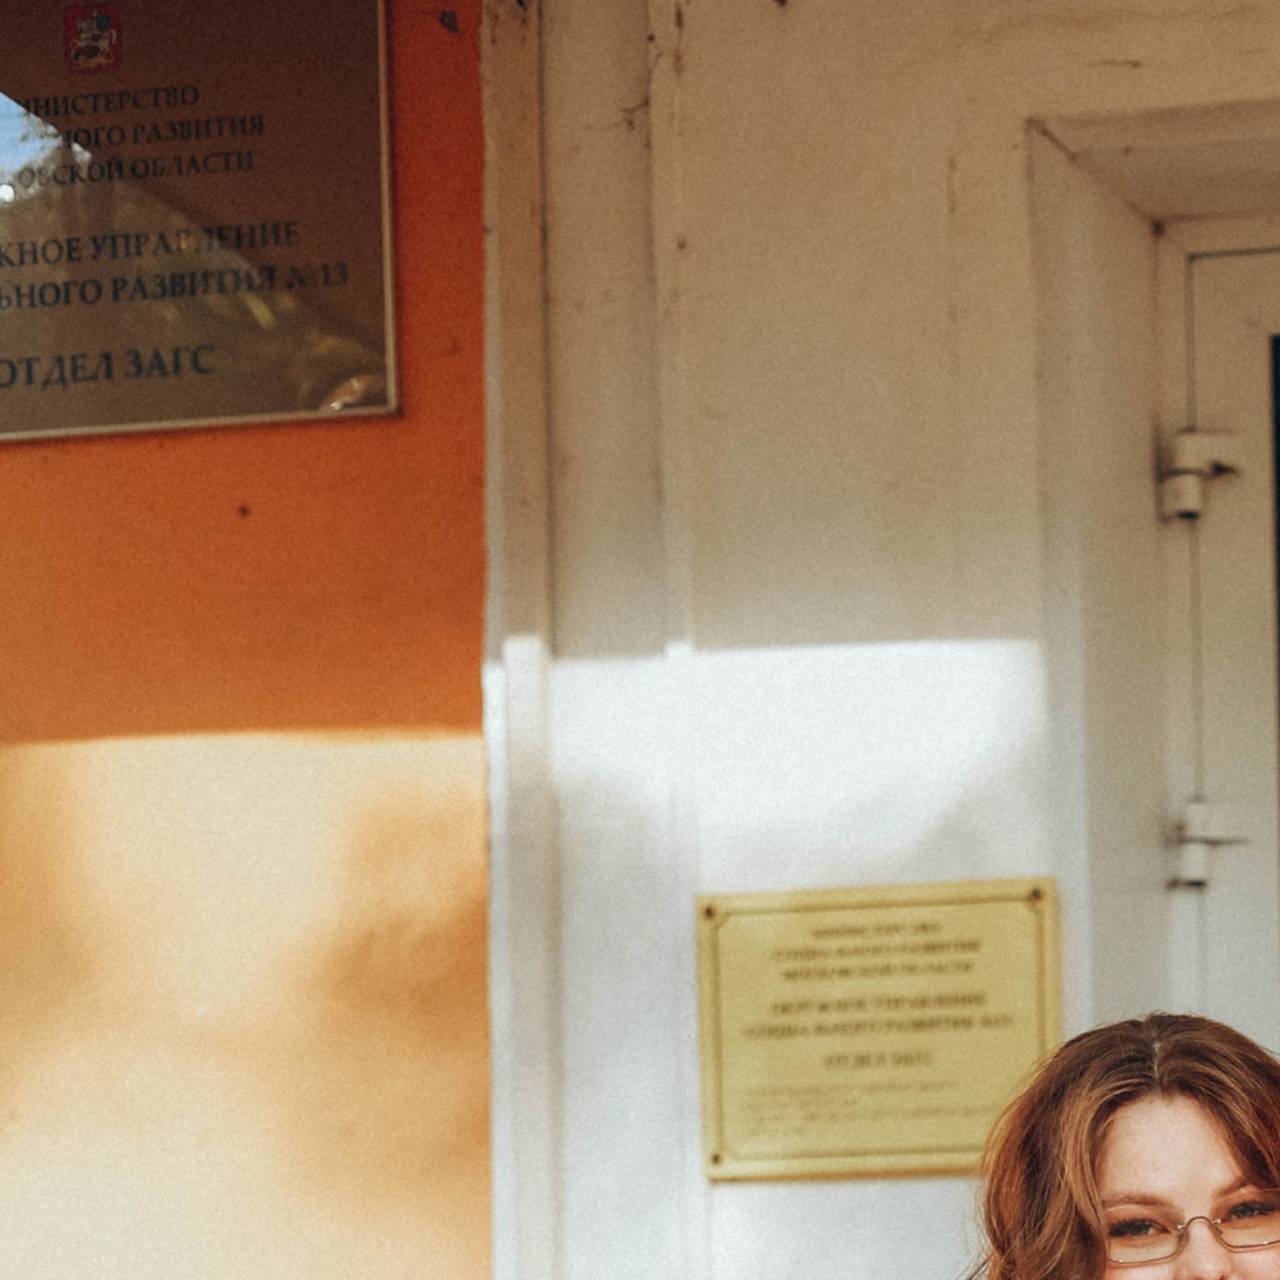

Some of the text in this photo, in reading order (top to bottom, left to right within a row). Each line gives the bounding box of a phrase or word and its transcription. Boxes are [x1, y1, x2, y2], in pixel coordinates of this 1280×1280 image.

[132, 115, 264, 144] РАЗВИТИЯ
[130, 150, 254, 180] ОБЛАСТИ
[122, 344, 216, 379] ЗАГС
